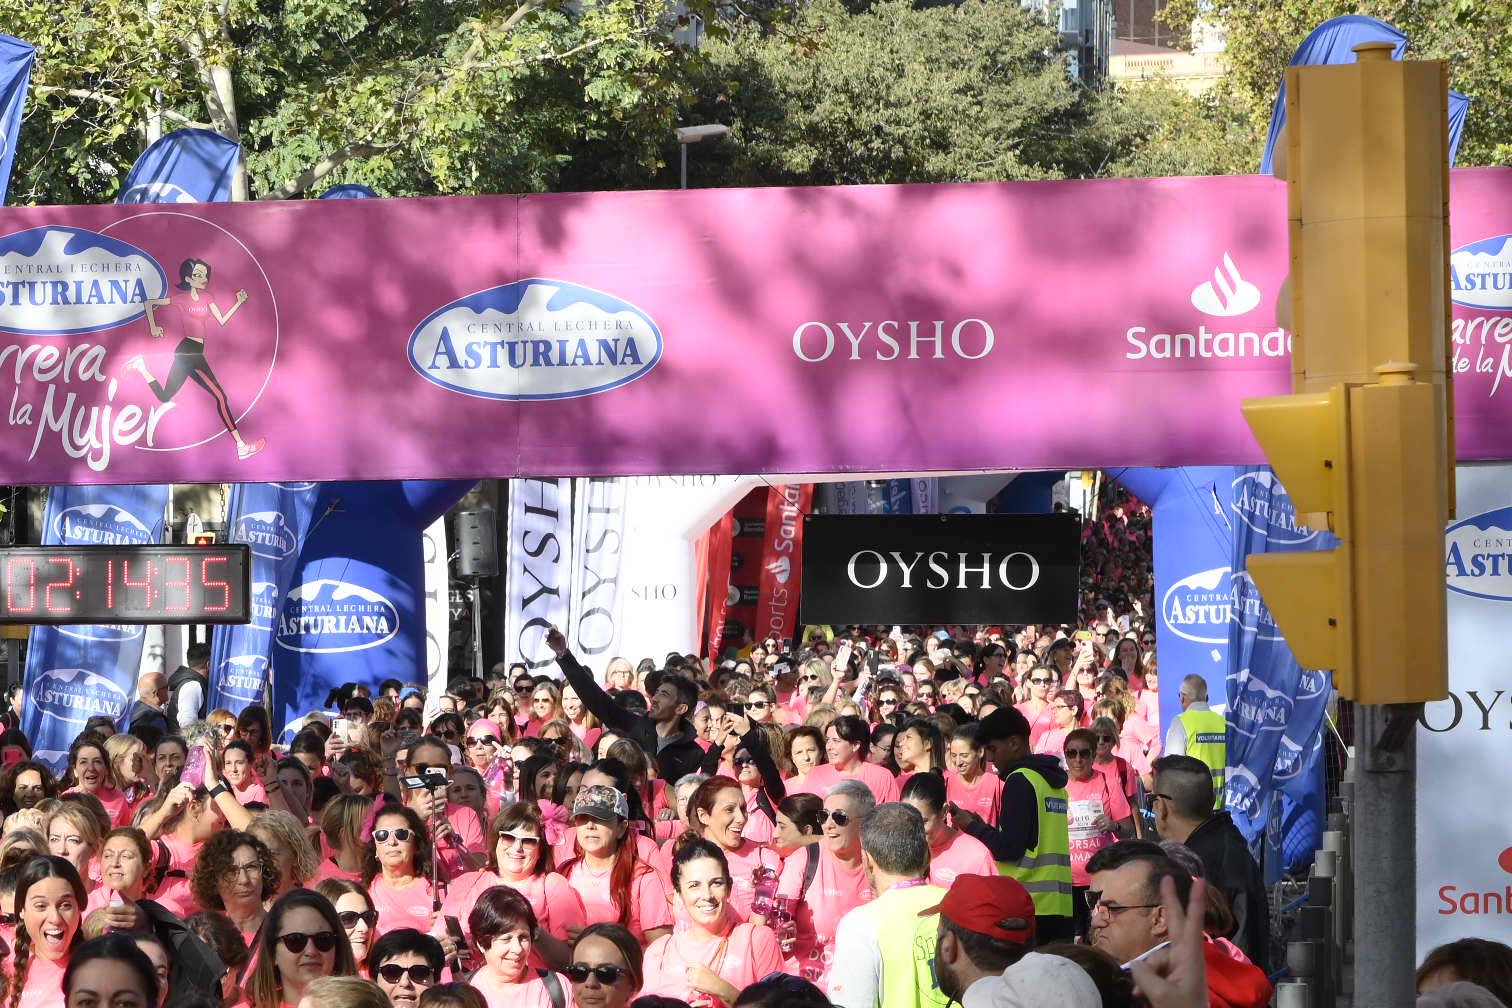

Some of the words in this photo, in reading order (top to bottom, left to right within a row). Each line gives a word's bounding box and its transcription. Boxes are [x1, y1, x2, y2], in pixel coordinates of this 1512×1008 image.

[70, 262, 143, 273] LECHERA
[467, 320, 545, 333] CENTRAL
[553, 318, 634, 331] LECHERA
[792, 318, 995, 362] OYSHO
[427, 326, 643, 370] ASTURIANA
[8, 387, 33, 426] la
[27, 378, 176, 471] Mujer
[1446, 542, 1512, 578] ASTU
[1473, 539, 1512, 548] CENT
[6, 556, 230, 612] 02:14:35
[519, 479, 561, 669] OYSH
[577, 479, 621, 655] OYSH
[848, 549, 1040, 591] OYSHO
[278, 615, 389, 636] ASTURIANA
[290, 604, 332, 613] CENTRAL
[336, 604, 385, 613] LECHERA
[36, 682, 121, 716] ASTURIANA
[1438, 885, 1512, 916] Sant
